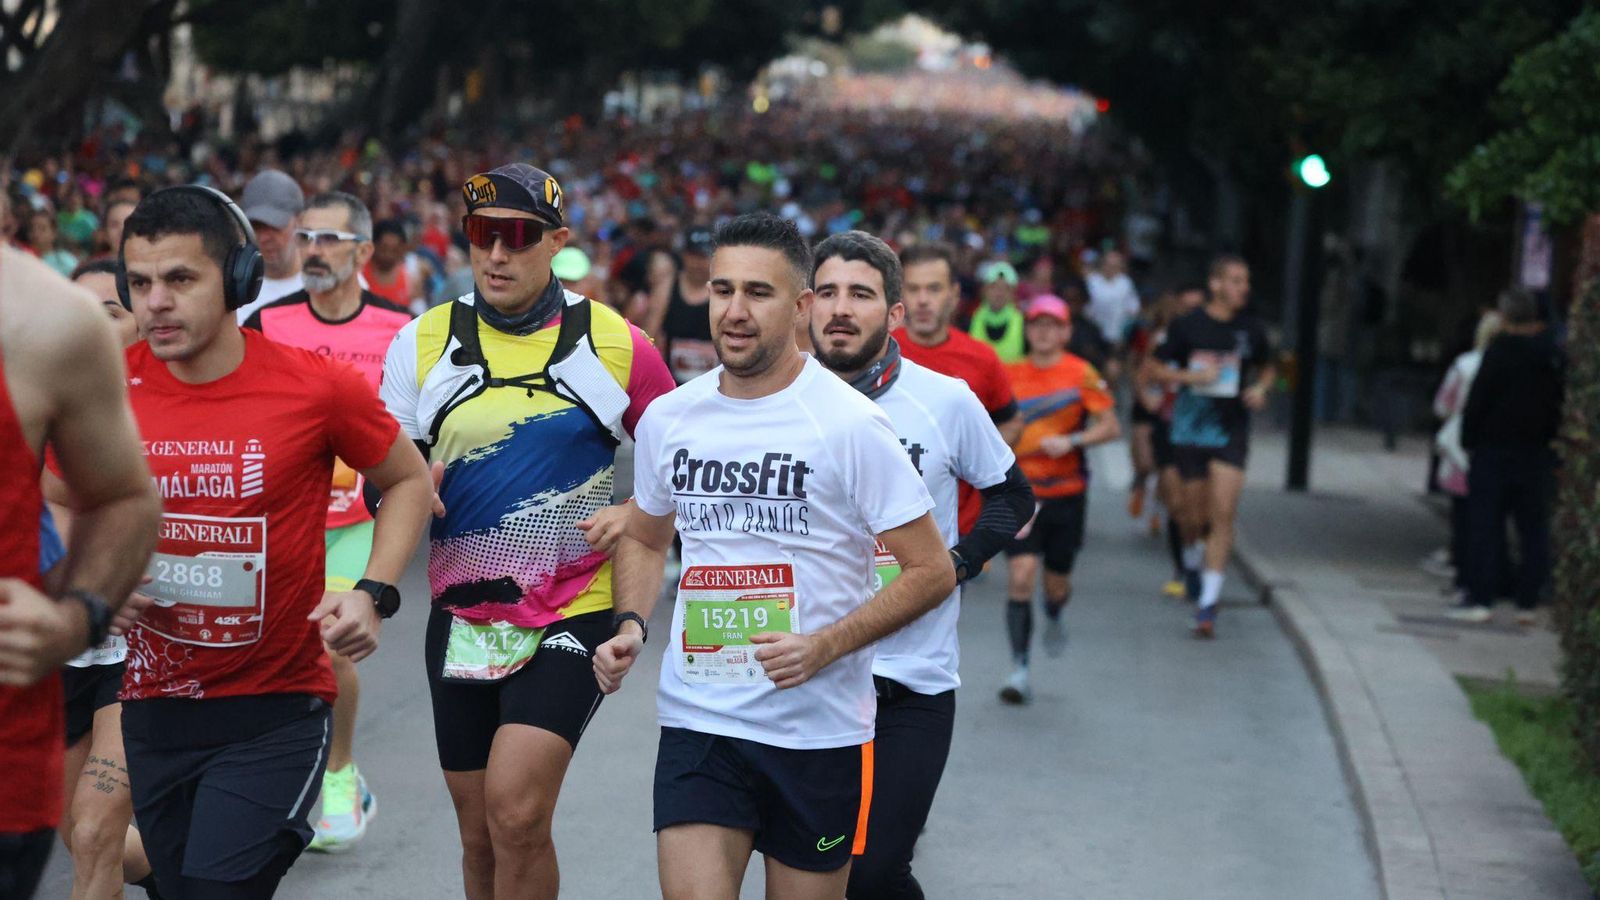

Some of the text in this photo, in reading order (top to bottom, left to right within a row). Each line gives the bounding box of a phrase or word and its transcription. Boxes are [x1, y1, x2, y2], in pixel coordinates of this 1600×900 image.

[151, 440, 235, 456] GENERALI
[672, 448, 810, 499] CrossFit
[151, 471, 236, 498] MÁLAGA
[676, 502, 810, 536] UERTO BANÚS
[158, 522, 253, 544] GENERALI
[156, 560, 223, 588] 2868
[704, 568, 785, 586] GENERALI
[214, 616, 241, 625] 42K
[701, 606, 768, 629] 15219
[475, 631, 525, 650] 4212
[722, 632, 743, 640] FRAN
[561, 645, 588, 657] TRAIL
